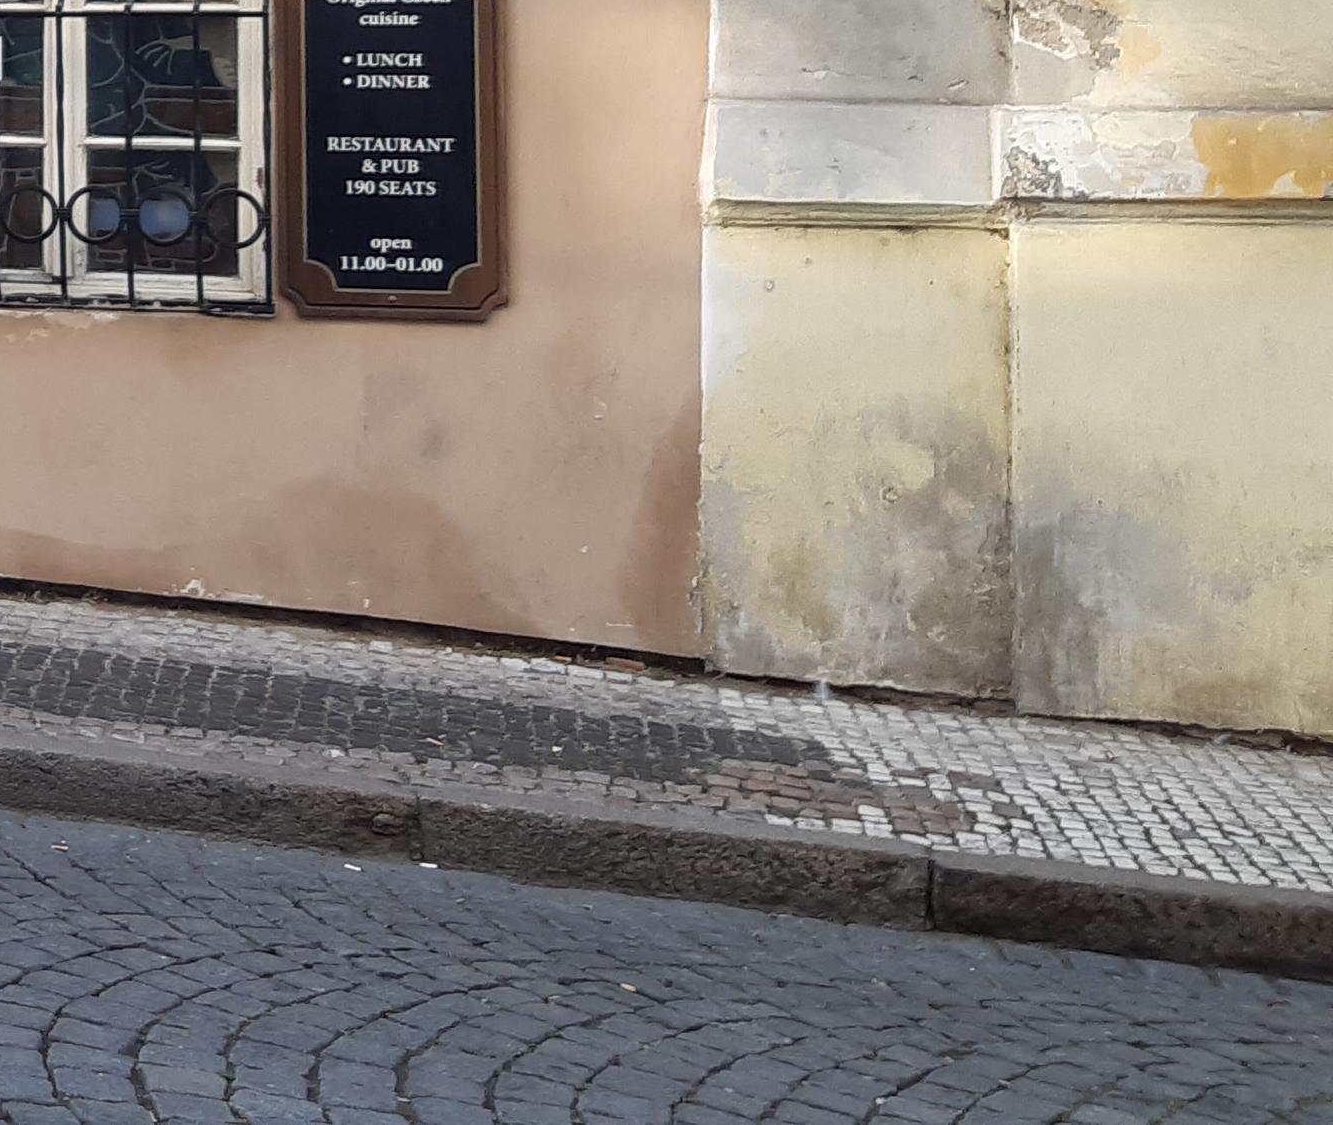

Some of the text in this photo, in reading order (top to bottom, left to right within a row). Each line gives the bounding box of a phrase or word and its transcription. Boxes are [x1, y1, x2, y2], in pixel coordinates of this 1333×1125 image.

[358, 11, 419, 25] cuisine
[356, 53, 422, 67] LUNCH
[356, 75, 430, 88] DINNER
[326, 136, 455, 152] RESTAURANT
[361, 159, 420, 174] & PUB
[345, 180, 437, 195] 190 SEATS
[369, 238, 412, 252] open
